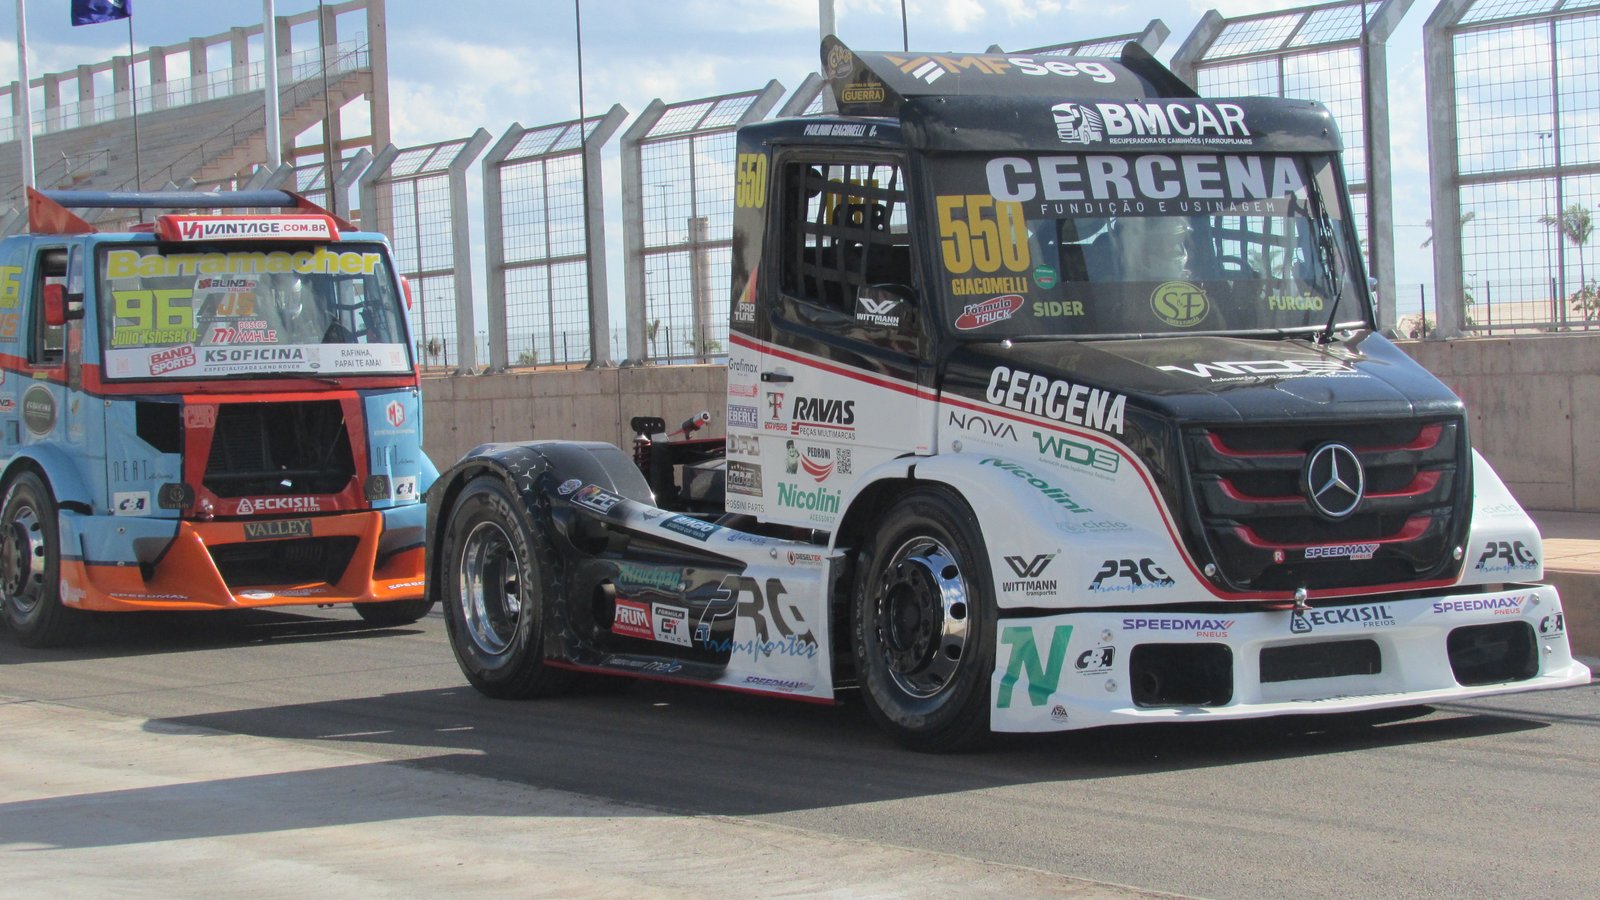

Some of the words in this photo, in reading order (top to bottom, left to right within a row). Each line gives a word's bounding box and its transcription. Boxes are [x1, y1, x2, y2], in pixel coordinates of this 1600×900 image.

[845, 91, 881, 101] GUERRA
[1096, 103, 1250, 136] BMCAR
[1109, 136, 1158, 145] RECUPERADORA
[737, 153, 768, 209] 550
[985, 155, 1308, 202] CERCENA
[1041, 200, 1145, 215] FUNDIÇÃO
[1159, 201, 1167, 212] E
[1180, 201, 1275, 213] USINAGEM
[205, 222, 326, 235] VANTAGE.COM.BR
[936, 195, 1031, 274] 550
[107, 247, 381, 279] Barramacher
[952, 277, 1028, 295] GIACOMELLI
[739, 303, 755, 312] PRO
[964, 297, 1012, 315] Fórmula
[1268, 291, 1323, 310] FURGÃO
[112, 289, 193, 331] 96
[734, 312, 755, 322] TUNE
[975, 309, 1012, 325] TRUCK
[1033, 301, 1084, 317] SIDER
[856, 313, 899, 323] WITTMANN
[151, 346, 192, 364] BAND
[230, 348, 303, 361] OFICINA
[151, 356, 195, 375] SPORTS
[335, 360, 355, 368] PAPAI
[355, 359, 364, 367] TE
[729, 357, 758, 373] Grafimax
[985, 365, 1128, 435] CERCENA
[729, 410, 757, 424] EBERLE
[792, 396, 855, 425] RAVAS
[800, 427, 817, 437] PEÇAS
[817, 428, 856, 440] MULTIMARCAS
[949, 410, 1018, 442] NOVA
[807, 446, 831, 460] PEDRONI
[1032, 431, 1120, 474] WDS
[978, 457, 1094, 514] Nicolini
[253, 496, 320, 510] ECKISIL
[777, 482, 842, 513] Nicolini
[747, 502, 765, 513] PARTS
[245, 520, 311, 537] VALLEY
[1305, 546, 1372, 557] SPEEDMAX
[1002, 579, 1057, 593] WITTMANN
[657, 609, 683, 618] FORMULA
[1432, 597, 1518, 615] SPEEDMAX
[1309, 605, 1394, 625] ECKISIL
[1123, 618, 1227, 630] SPEEDMAX
[1363, 620, 1396, 628] FREIOS
[697, 622, 819, 663] Transportes
[746, 675, 801, 689] SPEEDMAX
